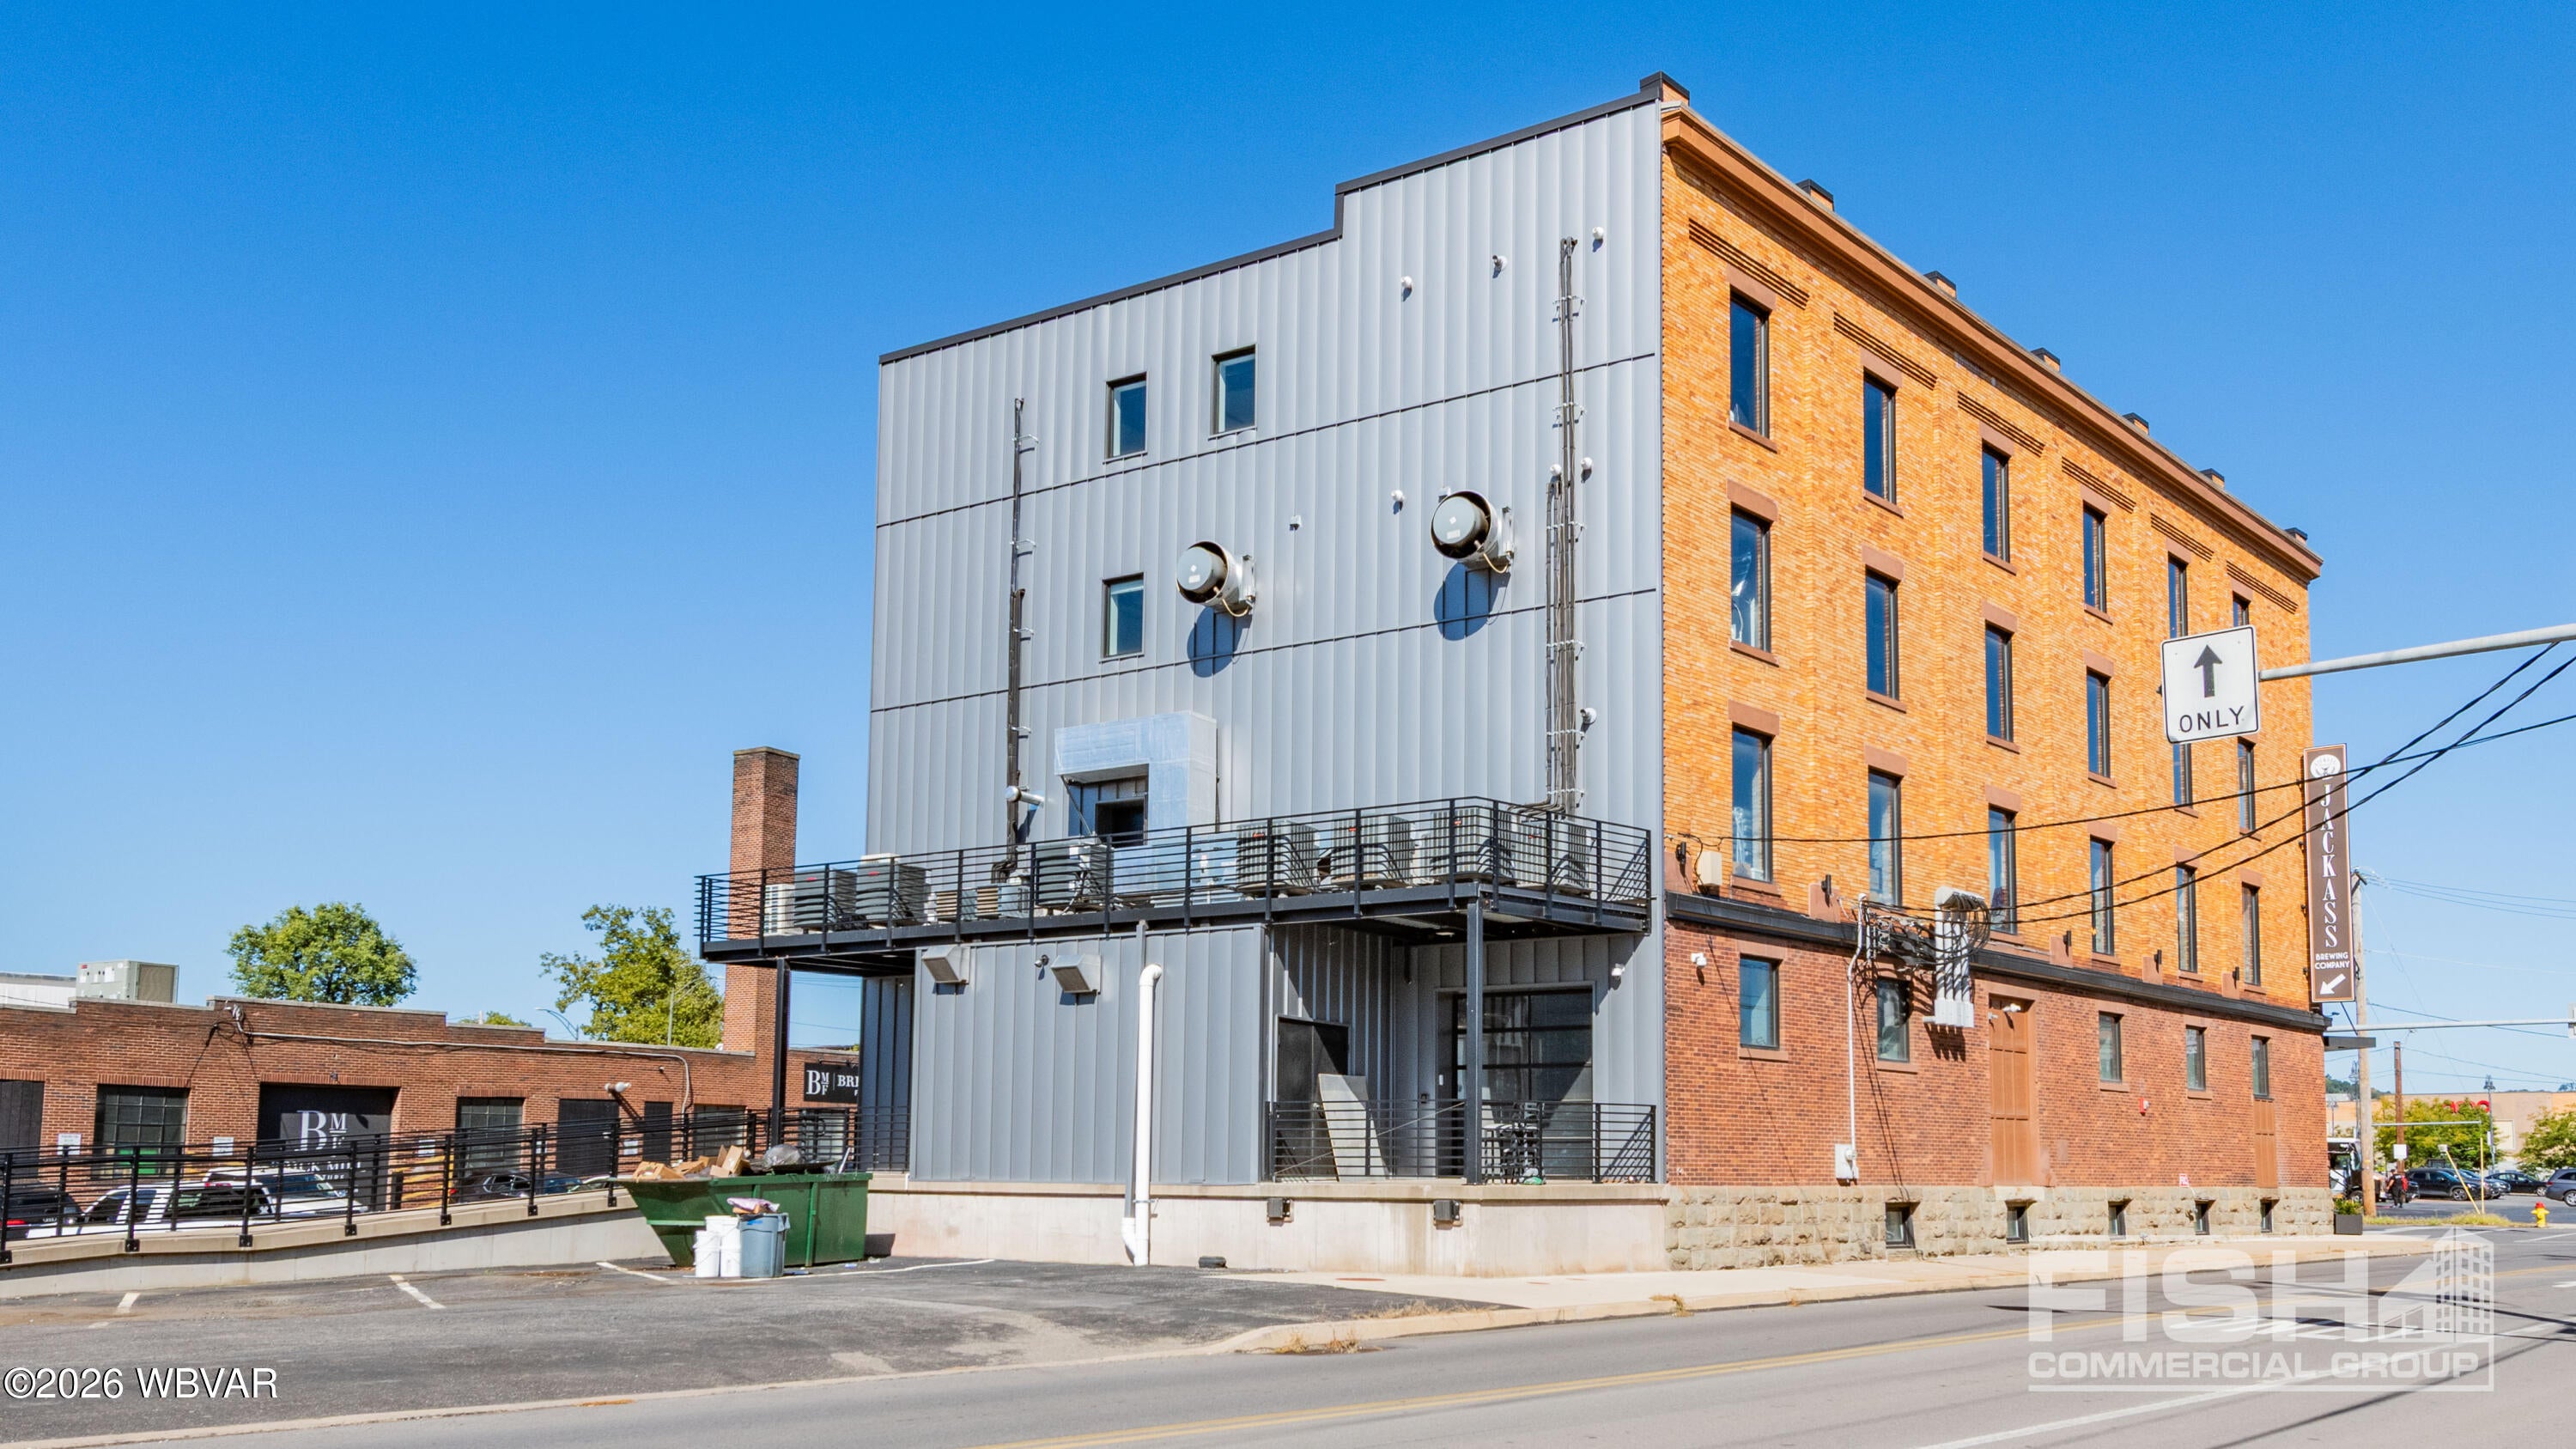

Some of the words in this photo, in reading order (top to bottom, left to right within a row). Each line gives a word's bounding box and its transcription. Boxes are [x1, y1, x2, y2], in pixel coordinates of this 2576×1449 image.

[2179, 705, 2245, 733] ONLY
[2319, 784, 2338, 948] JACKASS
[2314, 960, 2351, 970] COMPANY
[2315, 951, 2349, 961] BREWING
